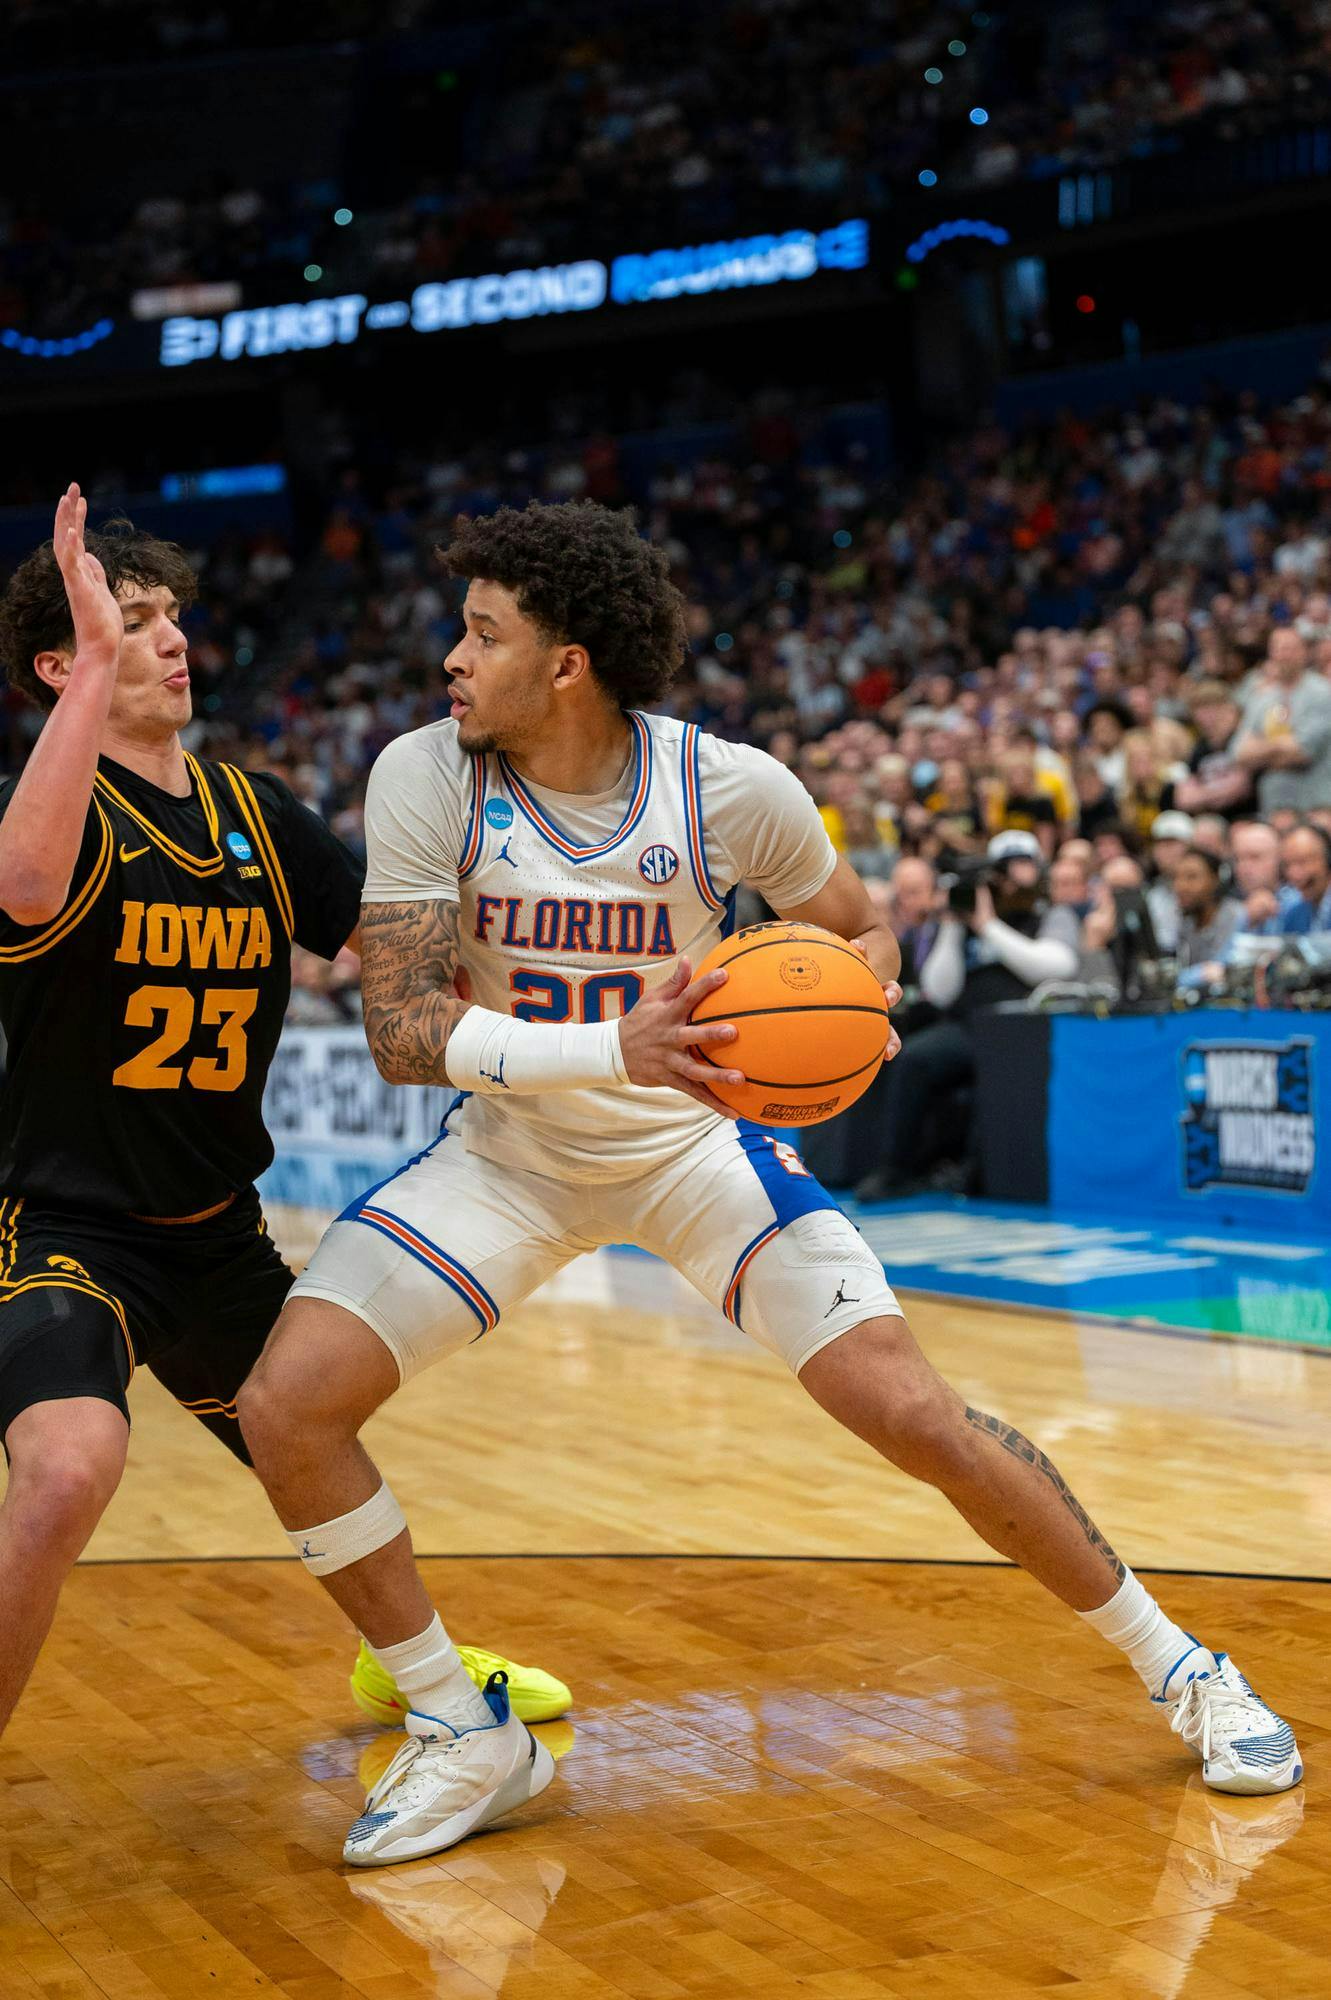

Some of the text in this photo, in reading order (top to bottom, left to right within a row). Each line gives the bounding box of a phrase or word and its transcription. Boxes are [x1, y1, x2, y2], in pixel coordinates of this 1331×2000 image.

[220, 294, 367, 360] FIRST
[410, 259, 607, 332] SECOND
[488, 810, 511, 822] NCAA
[642, 847, 676, 883] SEC
[114, 900, 272, 969] IOWA
[475, 894, 677, 957] FLORIDA
[509, 967, 645, 1025] 20
[112, 985, 259, 1092] 23
